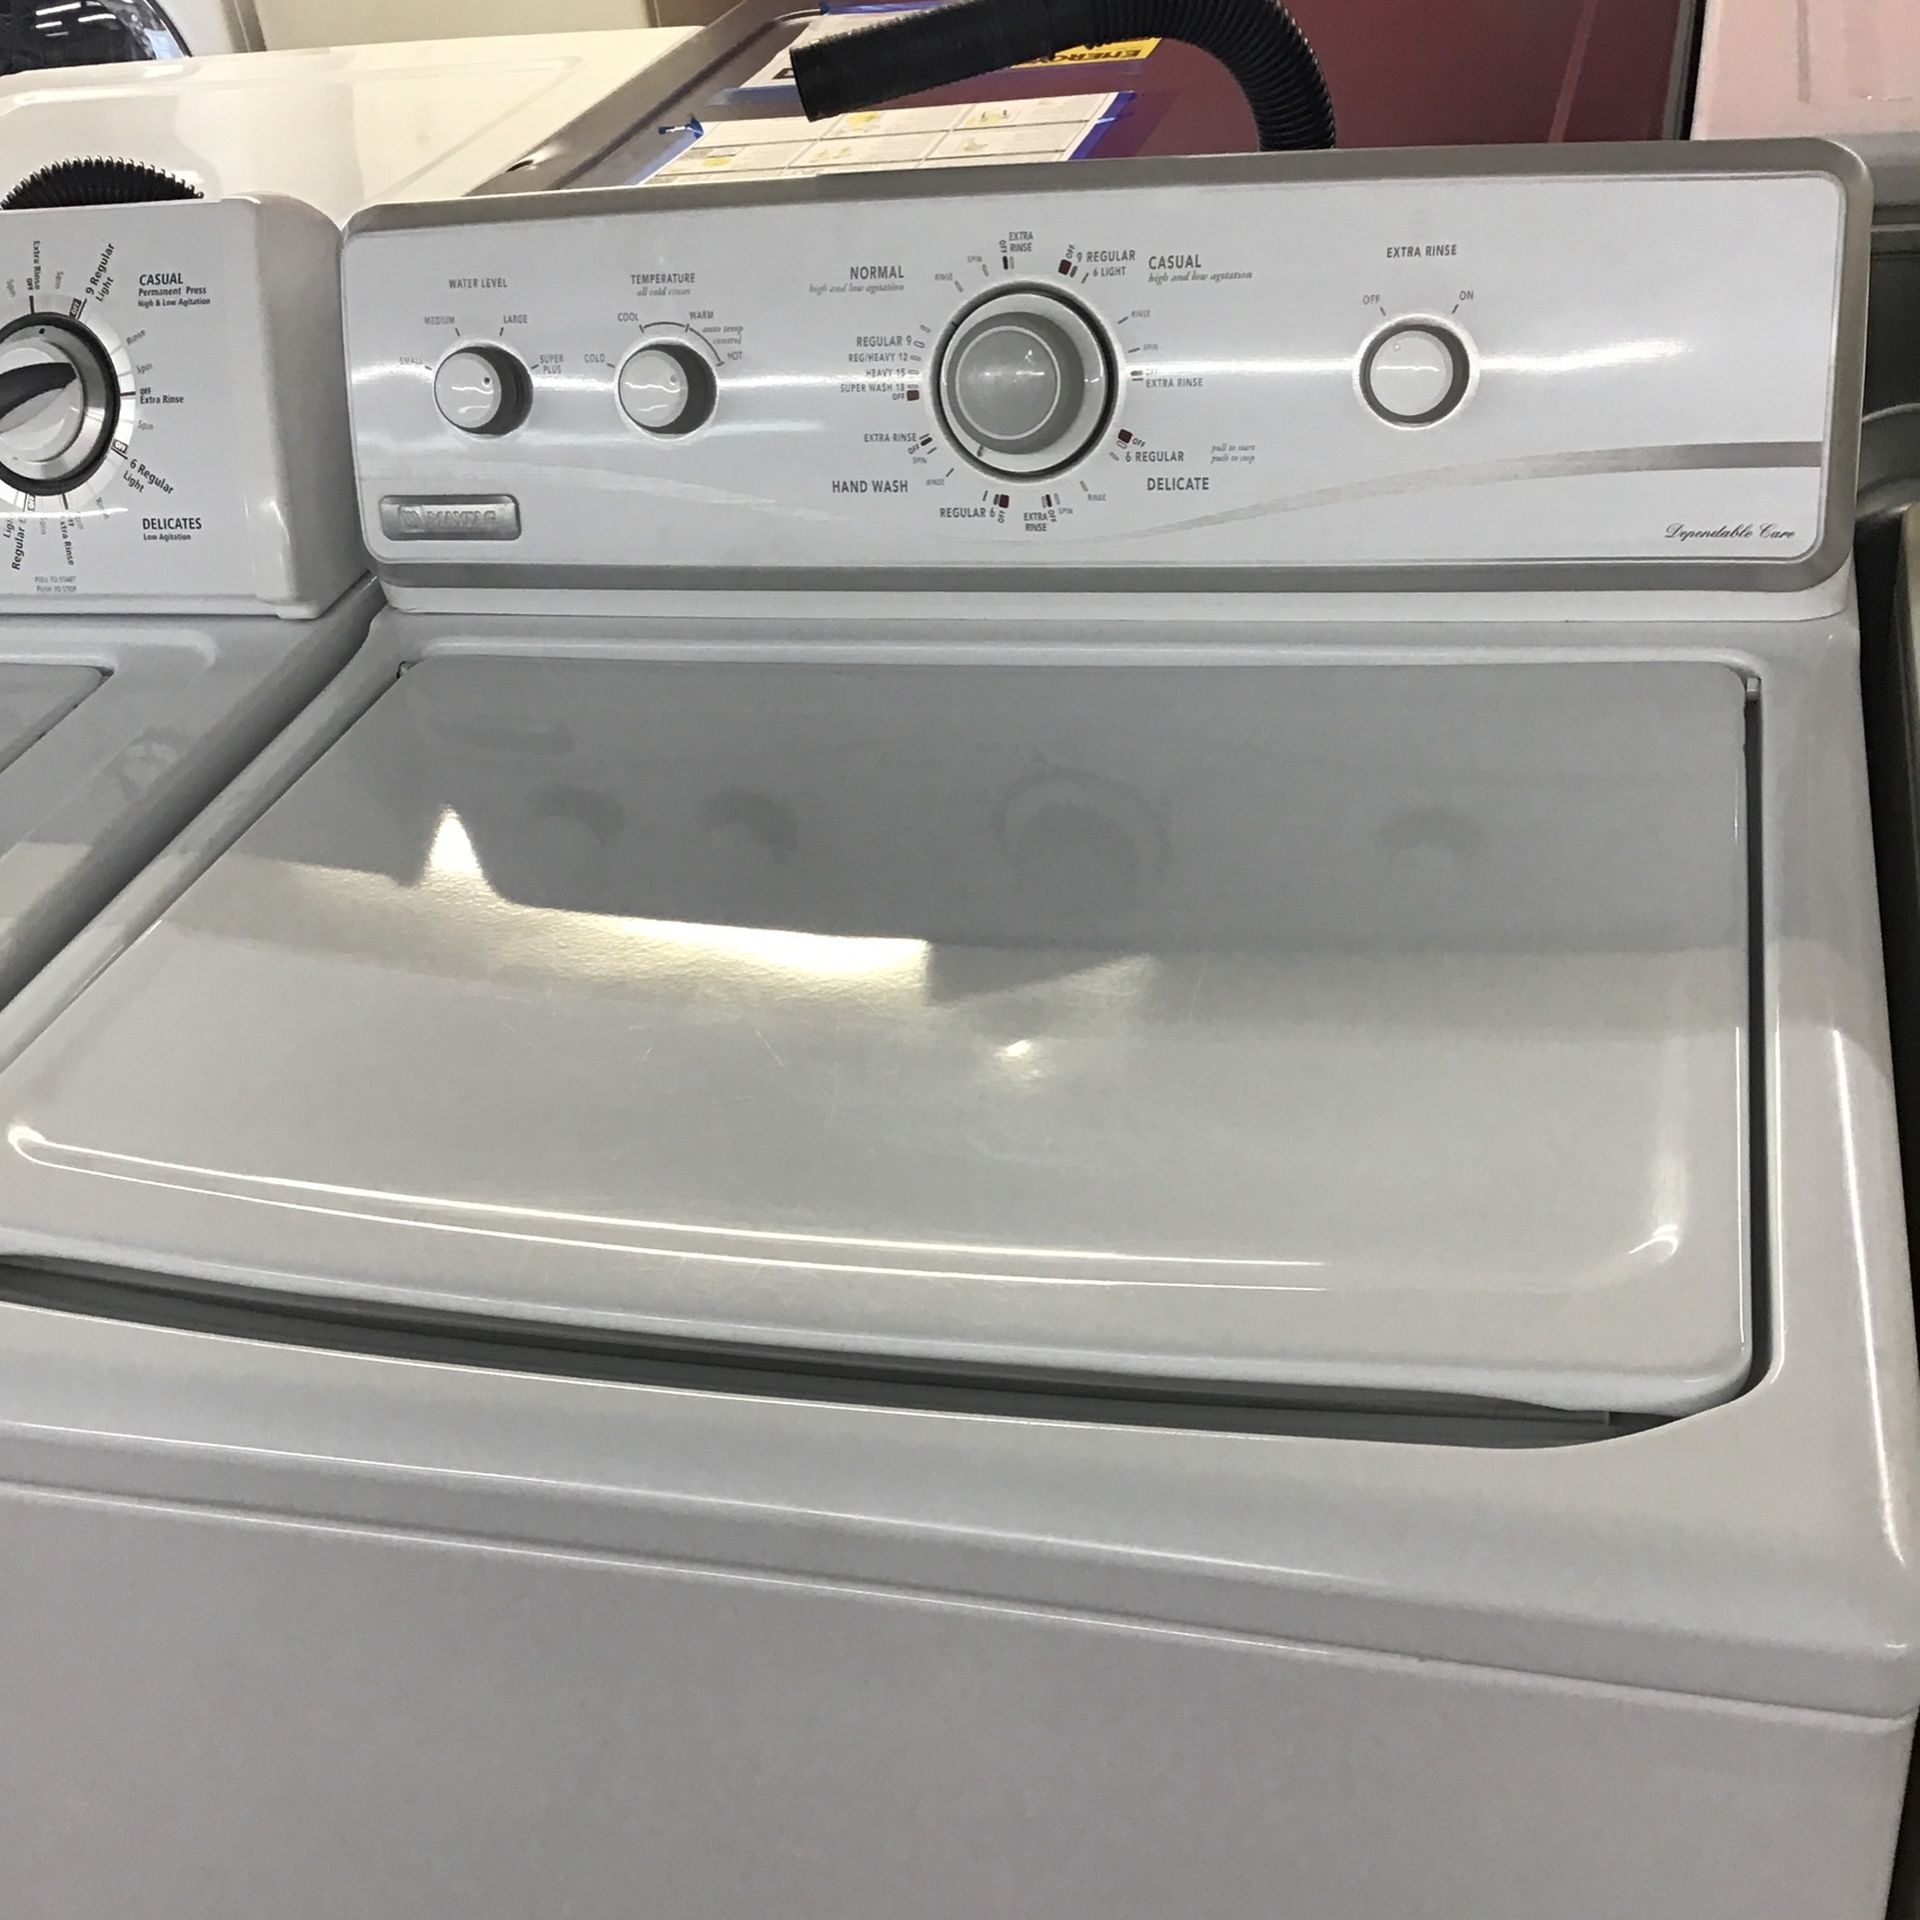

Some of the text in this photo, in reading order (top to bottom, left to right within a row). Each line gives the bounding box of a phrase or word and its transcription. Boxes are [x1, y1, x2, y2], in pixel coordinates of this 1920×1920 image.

[1009, 231, 1034, 241] EXTRA
[999, 239, 1008, 253] OFF
[1009, 243, 1032, 253] RINSE
[1065, 244, 1076, 259] OFF
[1386, 244, 1457, 258] EXTRA RINSE
[33, 240, 41, 264] Extra
[1076, 250, 1136, 263] 9 REGULAR
[1148, 254, 1202, 270] CASUAL
[85, 243, 115, 296] 9 Regular
[850, 265, 904, 280] NORMAL
[1093, 266, 1127, 277] 6 LIGHT
[139, 273, 183, 286] CASUAL
[630, 272, 696, 285] TEMPERATURE
[1148, 270, 1253, 285] high and low agitation
[95, 276, 115, 302] Light
[449, 278, 508, 289] WATER LEVEL
[808, 283, 828, 296] high
[829, 283, 847, 293] and
[848, 282, 863, 293] low
[138, 286, 207, 297] Permanent Press
[1459, 290, 1474, 301] ON
[138, 299, 154, 308] High
[162, 298, 177, 307] Low
[178, 298, 211, 307] Agitation
[1362, 295, 1380, 305] OFF
[503, 314, 528, 324] LARGE
[617, 312, 639, 322] COOL
[689, 310, 714, 320] WARM
[1131, 309, 1151, 318] RINSE
[424, 315, 455, 325] MEDIUM
[723, 325, 744, 335] temp
[126, 330, 147, 346] Rinse
[856, 335, 913, 348] REGULAR 9
[540, 354, 564, 364] SUPER
[584, 353, 606, 363] COLD
[727, 351, 743, 360] HOT
[848, 352, 908, 363] REG/HEAVY 12
[136, 363, 153, 374] Spin
[543, 365, 562, 374] PLUS
[866, 368, 906, 377] HEAVY 15
[840, 383, 867, 393] SUPER
[869, 383, 893, 393] WASH
[1145, 377, 1203, 388] EXTRA RINSE
[140, 386, 151, 395] OFF
[892, 391, 905, 401] OFF
[140, 395, 185, 404] Extra Rinse
[864, 432, 917, 443] EXTRA RINSE
[1132, 437, 1146, 448] OFF
[114, 440, 127, 452] OFF
[907, 444, 921, 455] OFF
[912, 456, 927, 465] SPIN
[1125, 451, 1184, 463] 6 REGULAR
[123, 470, 145, 493] Light
[129, 458, 174, 495] 6 Regular
[832, 480, 908, 493] HAND WASH
[1146, 477, 1210, 491] DELICATE
[940, 507, 996, 518] REGULAR 6
[1023, 512, 1047, 522] EXTRA
[1058, 507, 1074, 516] SPIN
[143, 517, 202, 530] DELICATES
[1025, 522, 1047, 532] RINSE
[144, 532, 191, 542] Low Agitation
[1664, 523, 1795, 542] Dependable Care
[12, 527, 25, 570] Regular
[64, 540, 75, 566] Rinse
